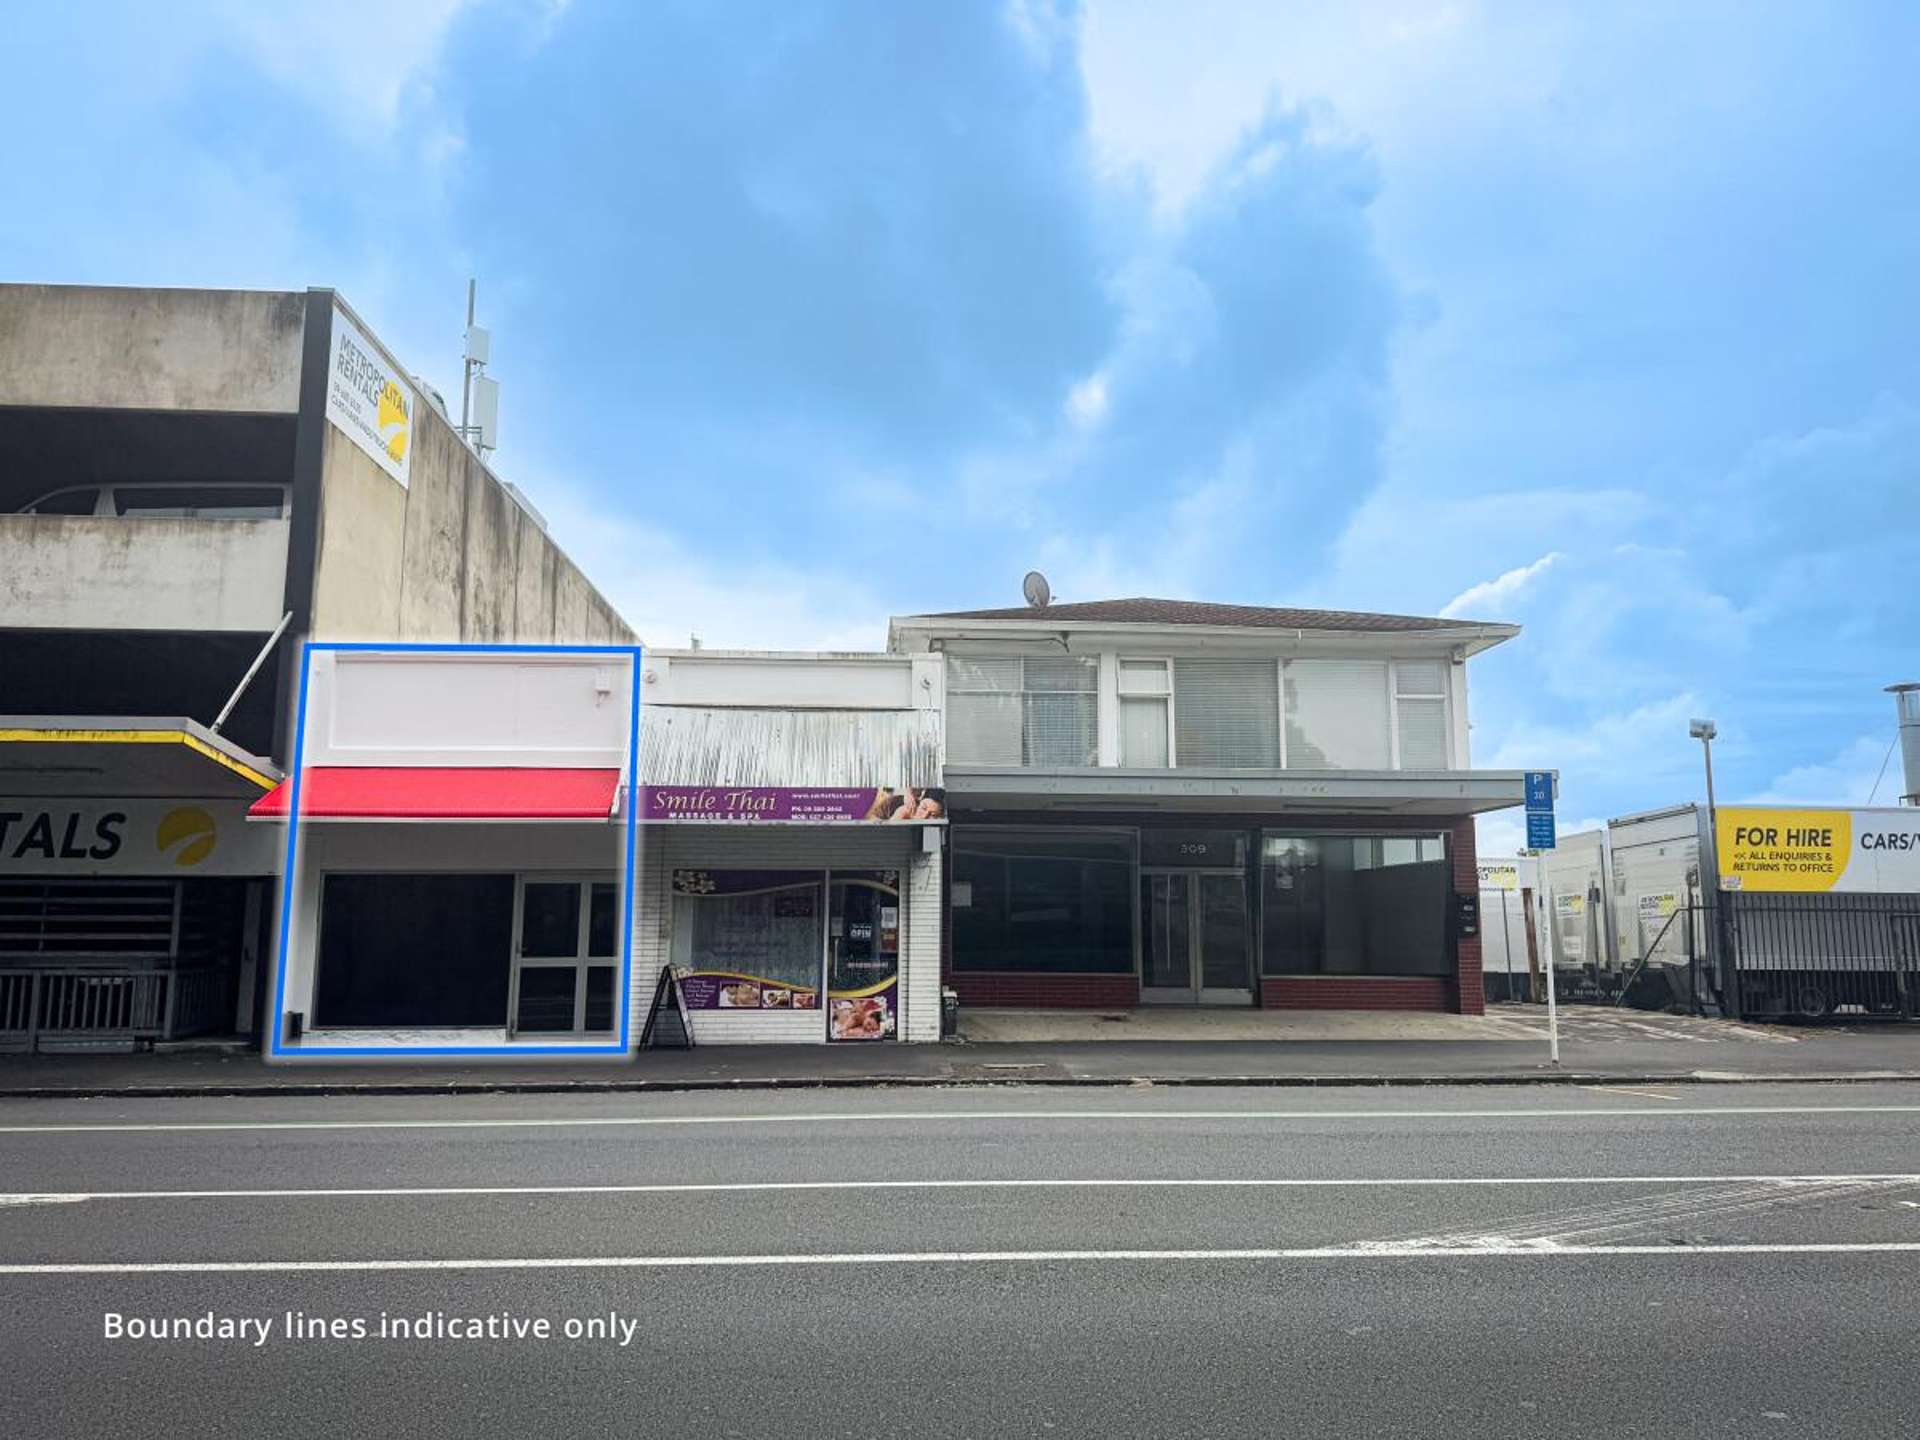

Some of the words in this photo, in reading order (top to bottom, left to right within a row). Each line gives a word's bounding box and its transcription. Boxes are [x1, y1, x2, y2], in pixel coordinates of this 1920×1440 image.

[337, 354, 379, 408] RENTALS
[340, 332, 410, 420] METROPOLITAN
[1533, 774, 1543, 785] P
[653, 789, 716, 810] Smile
[725, 789, 777, 810] Thai
[1735, 828, 1778, 847] FOR
[1786, 829, 1832, 847] HIRE
[1860, 832, 1920, 851] CARS/
[1749, 852, 1766, 860] ALL
[1769, 852, 1822, 861] ENQUIRIES
[1825, 853, 1832, 861] &
[1733, 863, 1780, 872] RETURNS
[1783, 864, 1797, 872] TO
[1800, 864, 1833, 872] OFFICE
